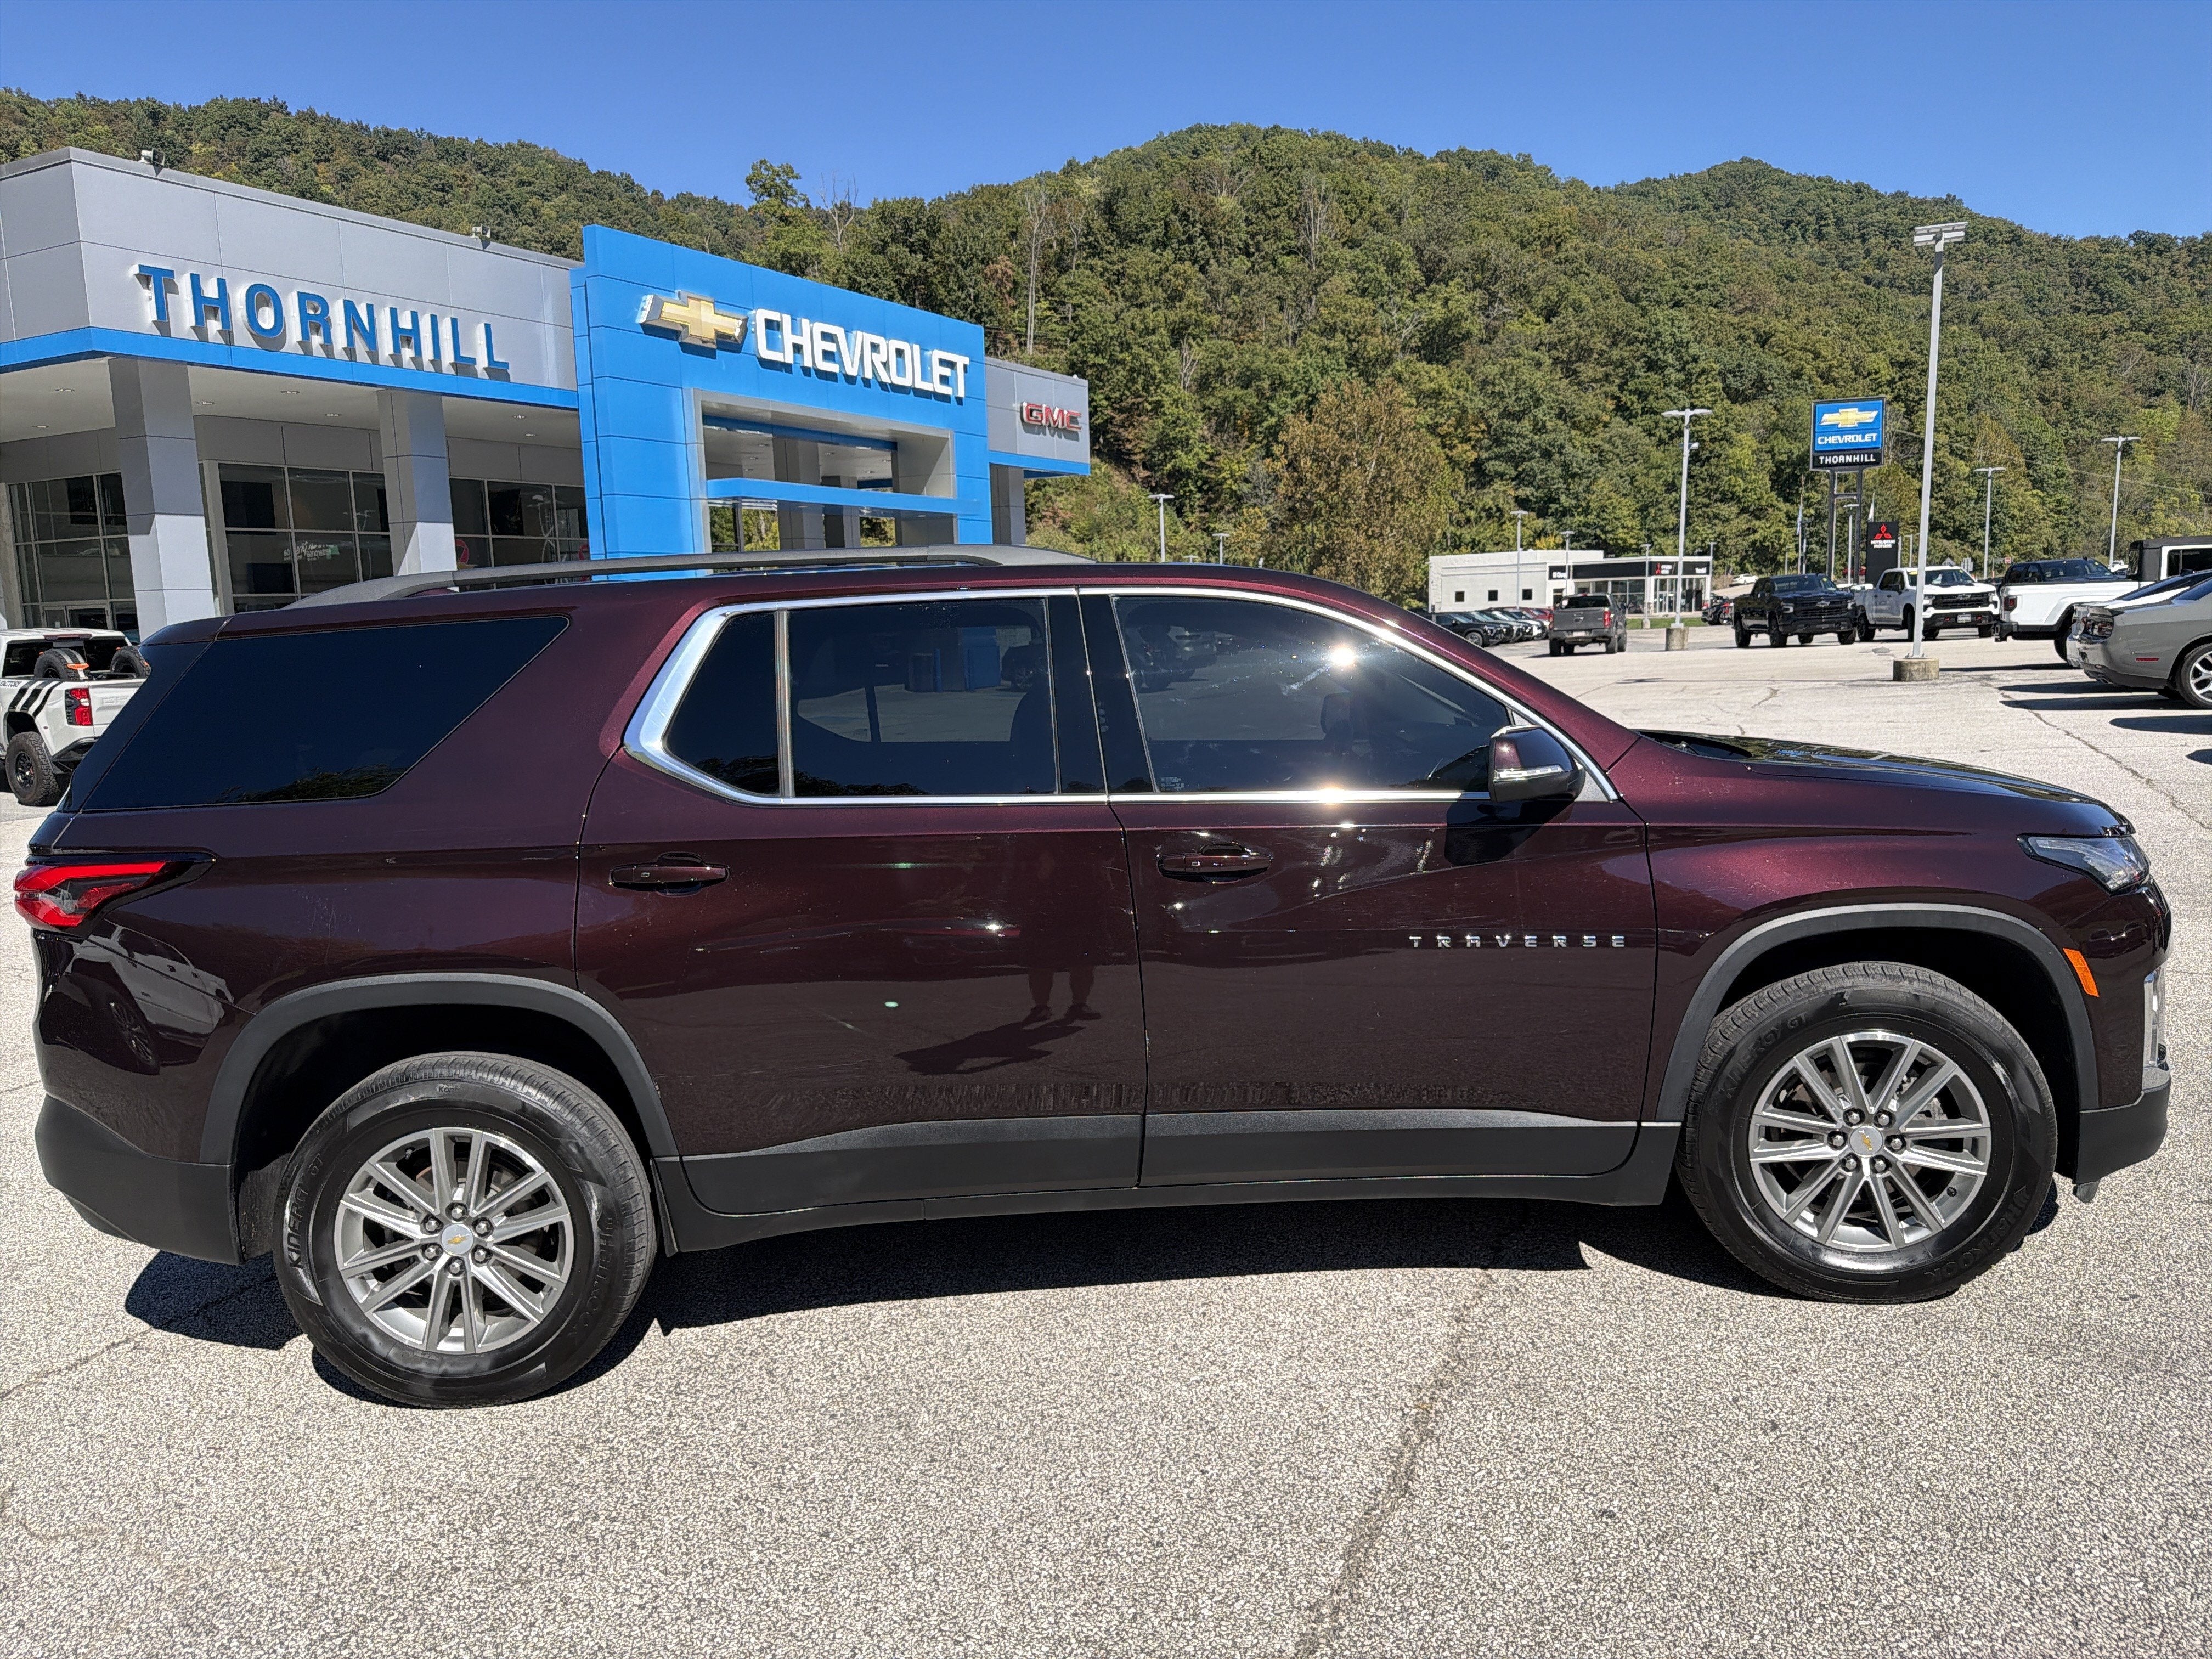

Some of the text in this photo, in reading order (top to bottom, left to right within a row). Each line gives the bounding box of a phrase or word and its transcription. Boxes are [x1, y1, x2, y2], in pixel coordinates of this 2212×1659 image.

[136, 264, 510, 370] THORNHILL
[755, 308, 970, 398] CHEVROLET
[1022, 402, 1082, 432] GMC
[1818, 433, 1878, 445] CHEVROLET
[1819, 454, 1876, 464] THORNHILL
[1409, 935, 1625, 948] TRAVERSE
